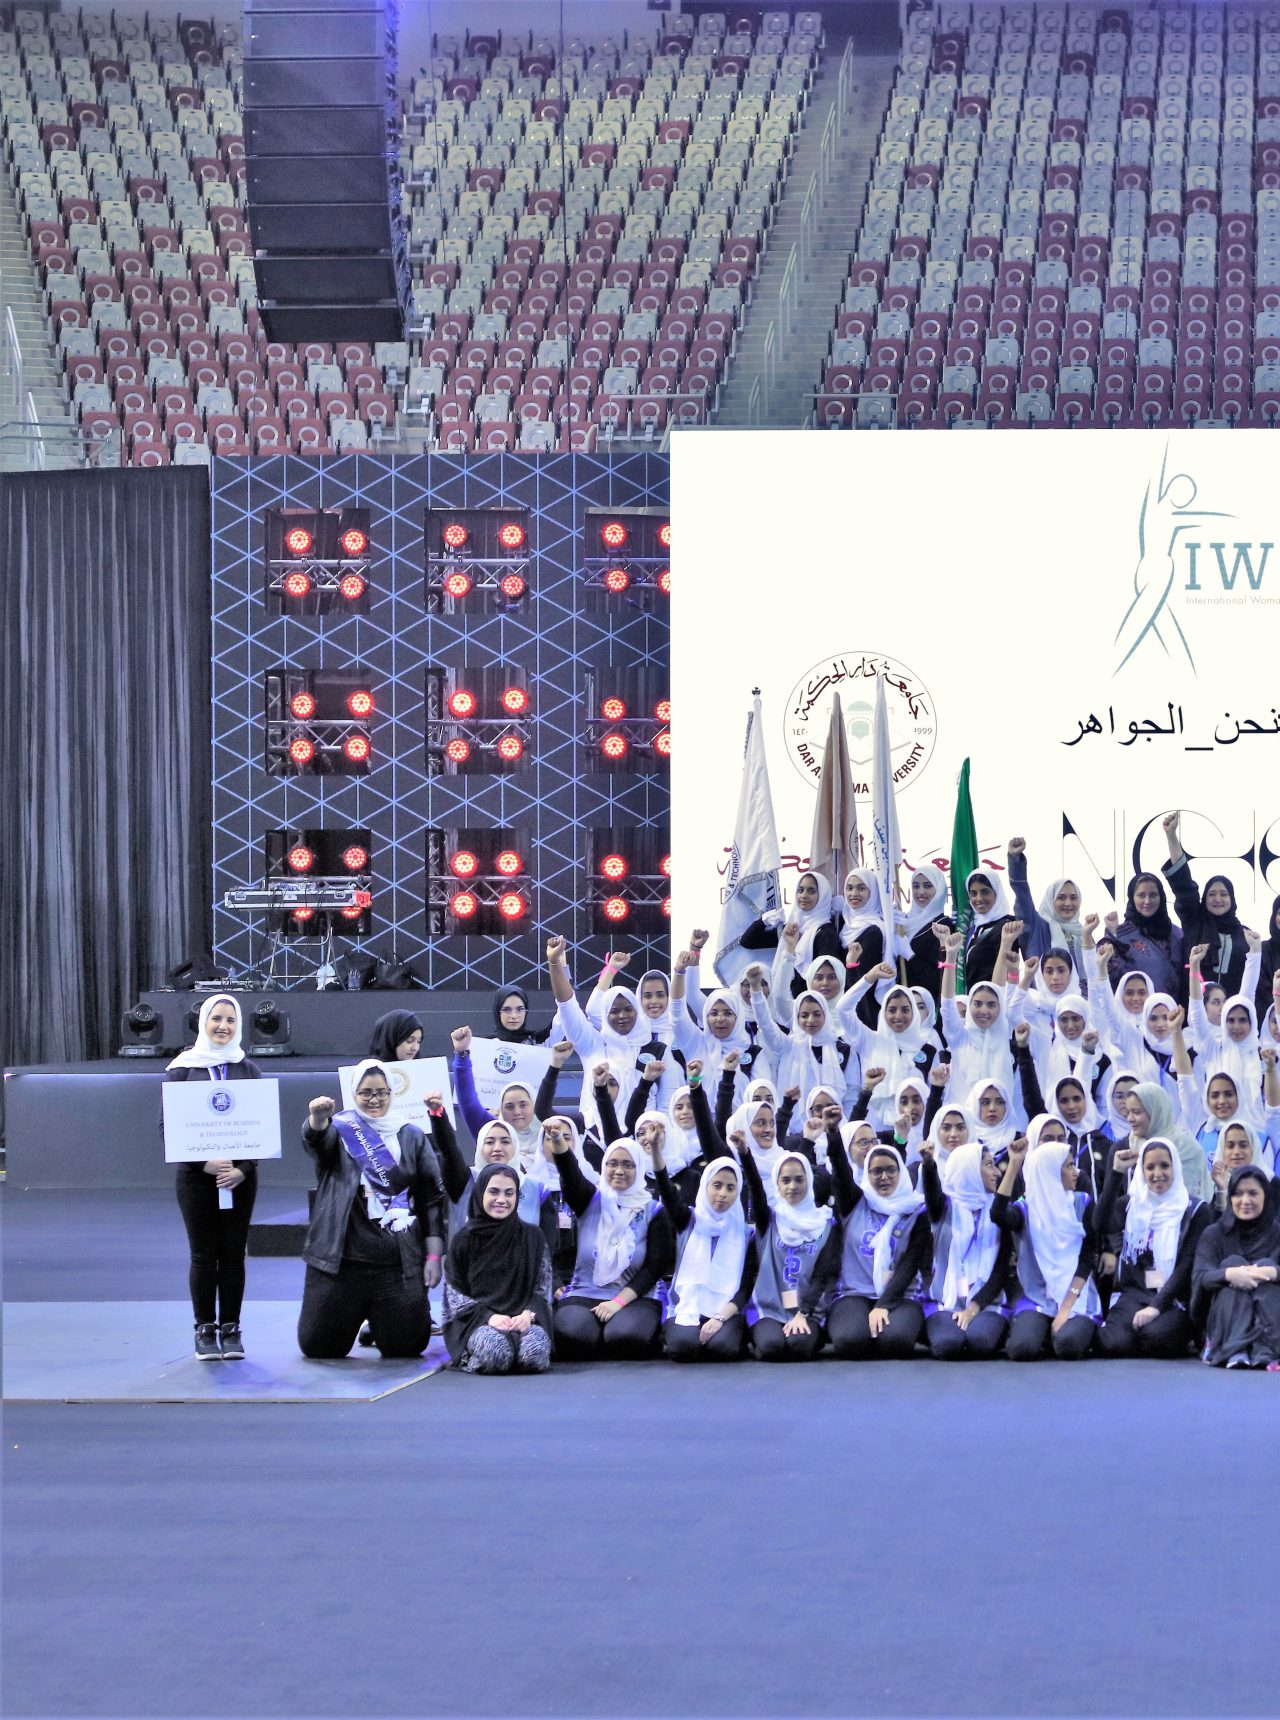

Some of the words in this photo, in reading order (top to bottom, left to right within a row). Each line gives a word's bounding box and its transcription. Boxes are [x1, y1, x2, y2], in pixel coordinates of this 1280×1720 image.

[1186, 595, 1247, 605] International
[797, 743, 816, 768] DAR
[893, 742, 925, 783] VERSITY
